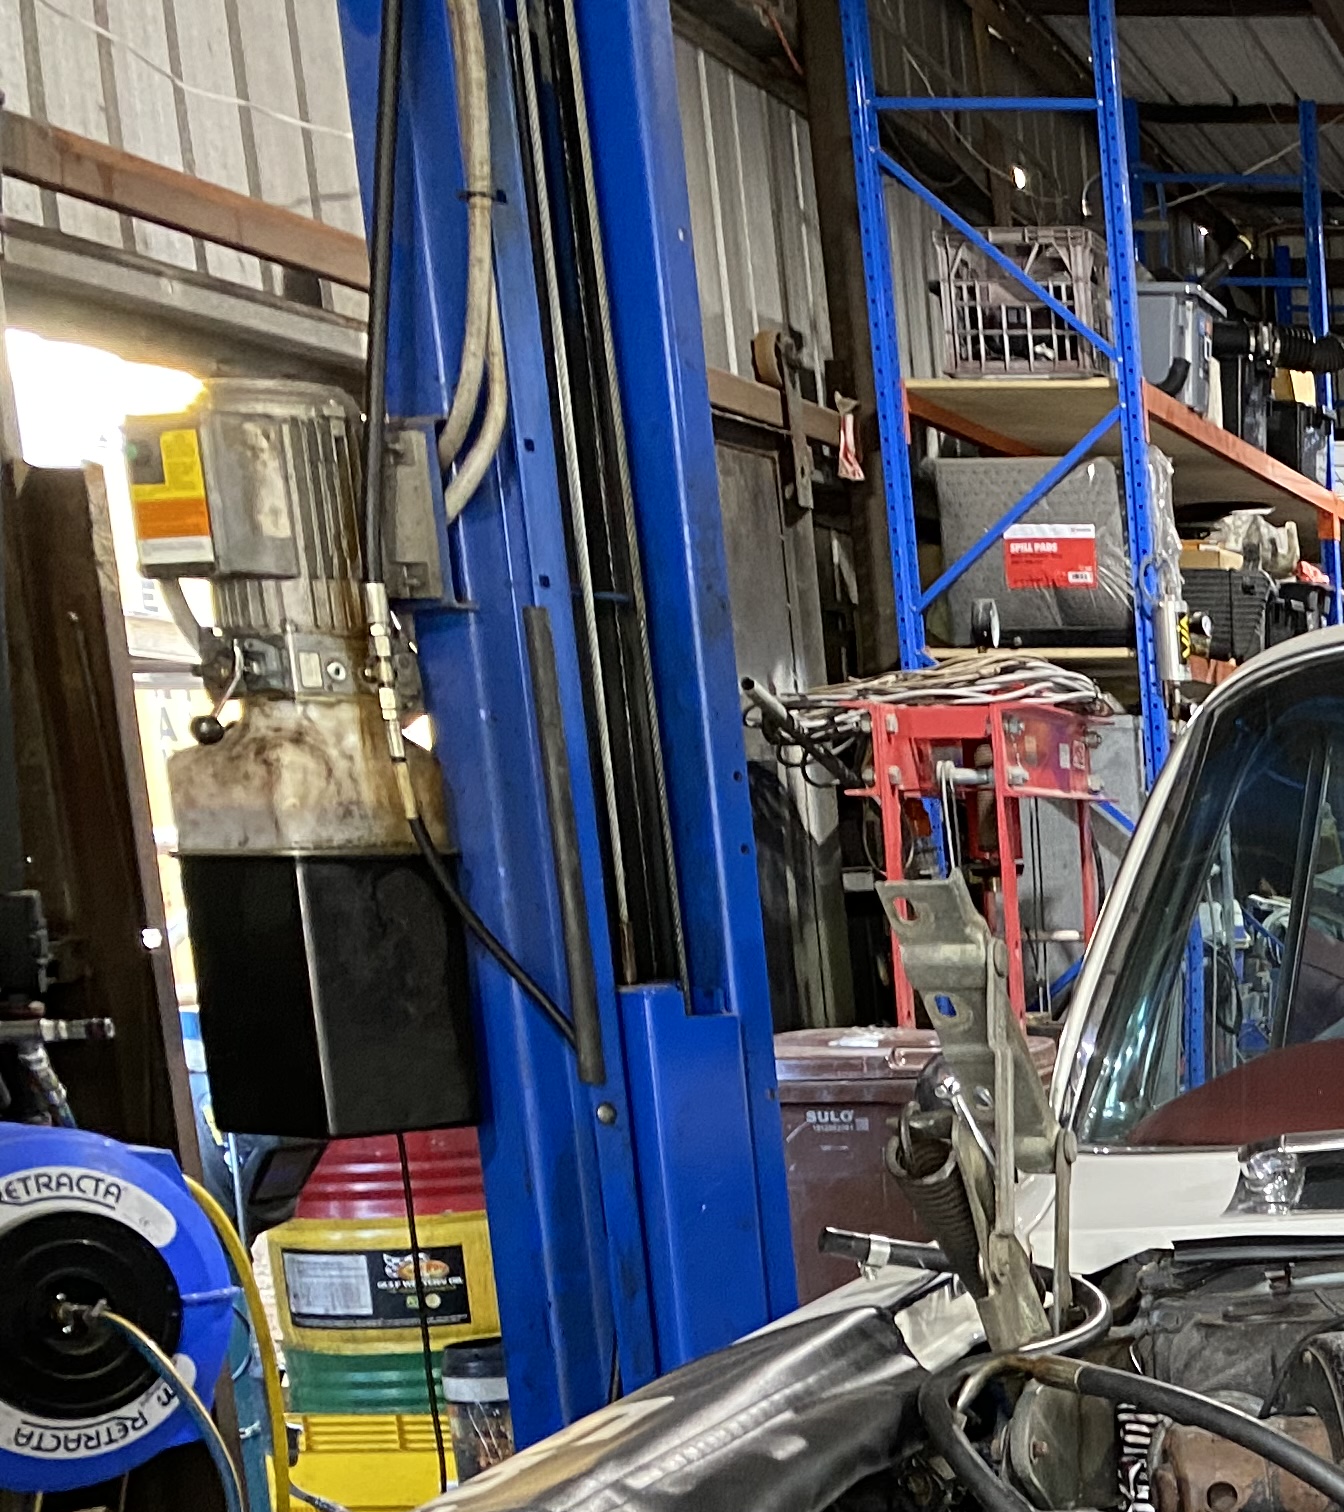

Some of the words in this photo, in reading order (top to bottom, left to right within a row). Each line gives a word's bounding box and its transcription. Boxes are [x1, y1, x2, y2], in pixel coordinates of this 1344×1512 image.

[806, 1110, 853, 1123] SULO
[0, 1173, 122, 1203] ETRACTA
[14, 1409, 149, 1452] RETRACTA
